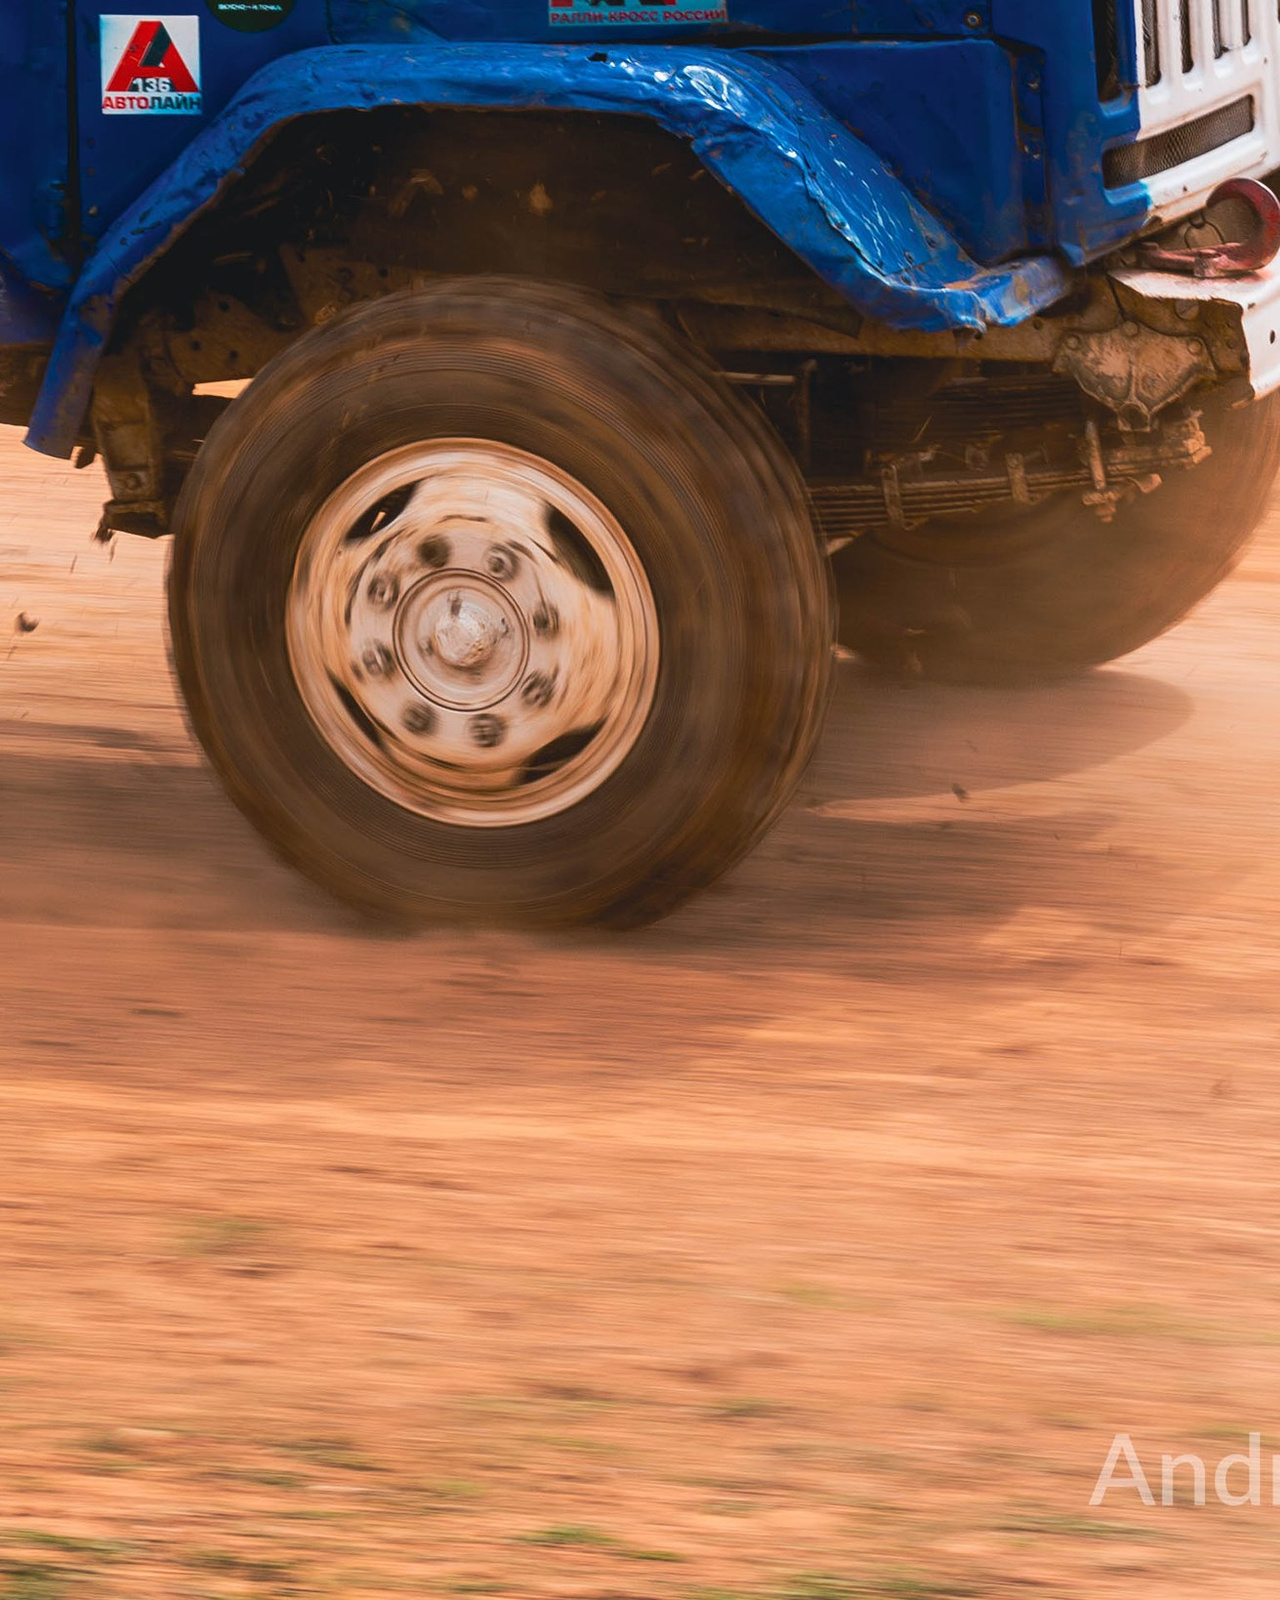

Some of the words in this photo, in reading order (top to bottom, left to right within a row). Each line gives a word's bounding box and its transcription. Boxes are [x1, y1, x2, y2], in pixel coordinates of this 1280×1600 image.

[550, 9, 661, 24] РАЛЛИ-КРОСС
[663, 8, 727, 22] РОССИИ
[132, 77, 171, 92] 136
[102, 94, 202, 110] АВТОЛАЙН
